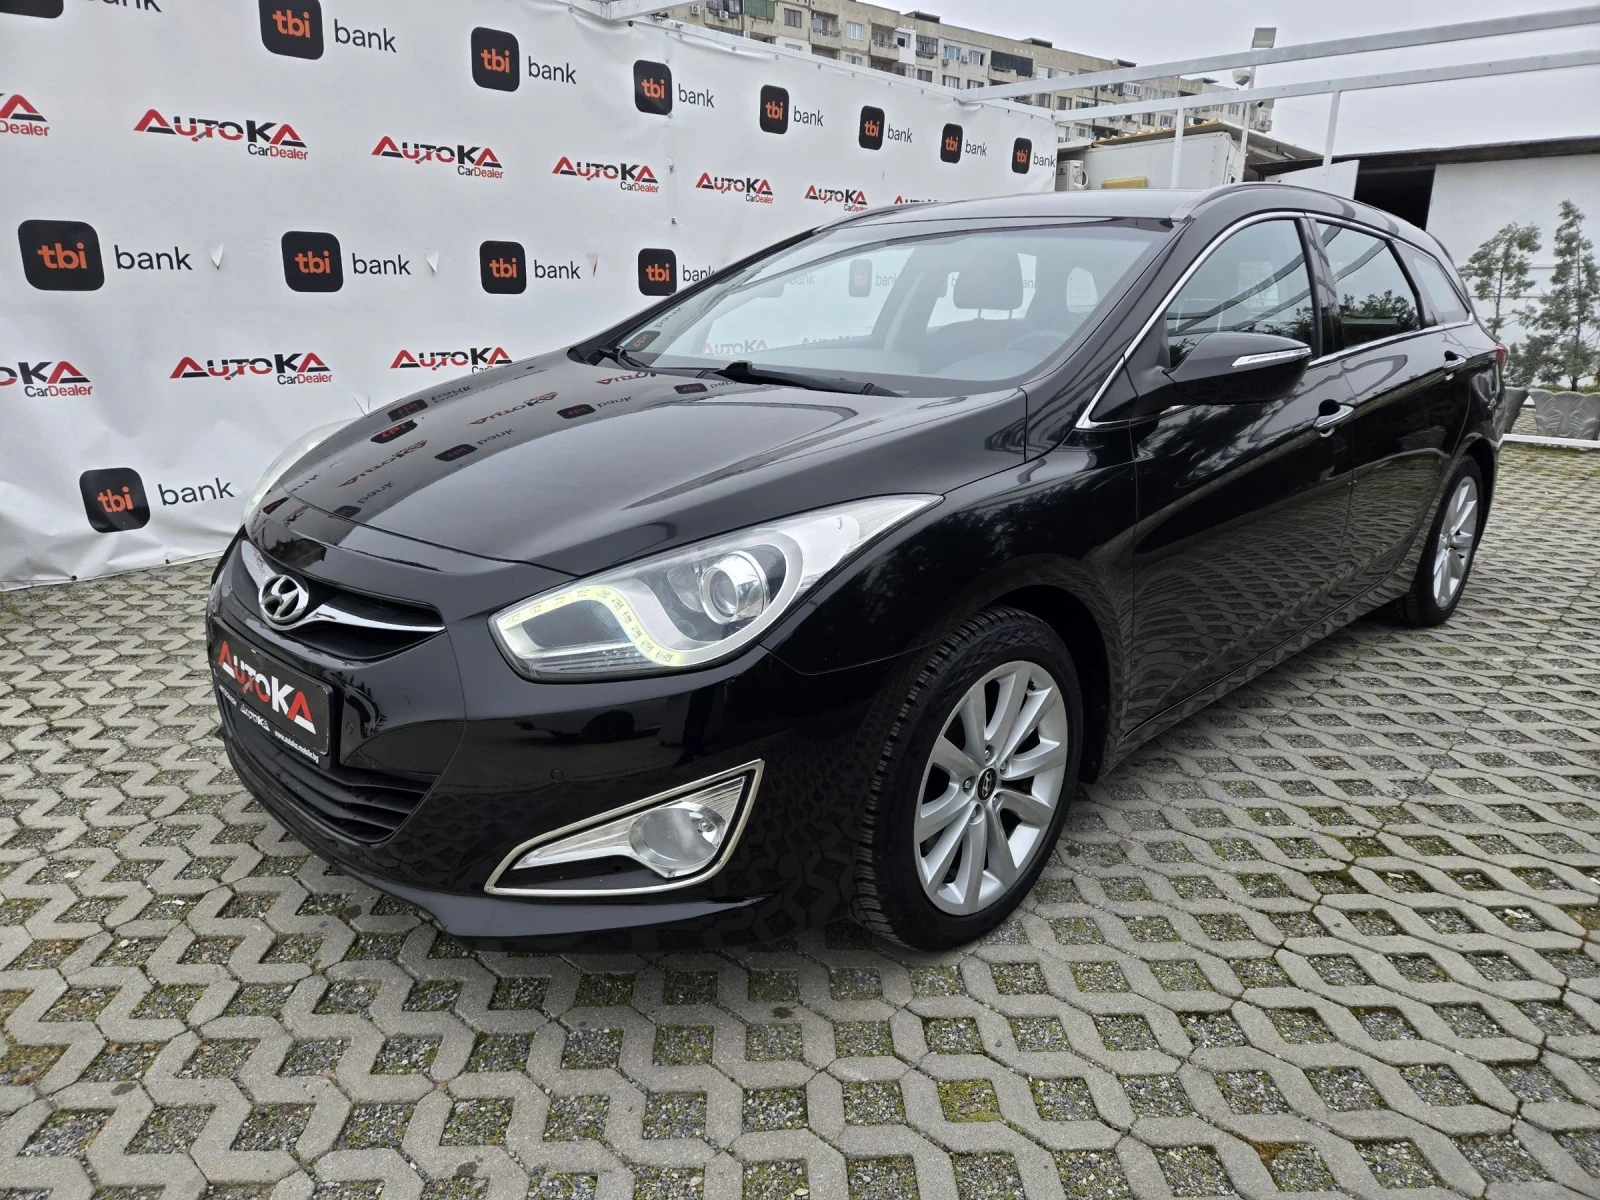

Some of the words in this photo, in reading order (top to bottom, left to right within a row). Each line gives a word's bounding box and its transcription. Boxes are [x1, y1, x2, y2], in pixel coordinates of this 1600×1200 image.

[272, 10, 311, 39] tbi
[334, 19, 397, 53] bank
[480, 49, 511, 73] tbi
[528, 56, 577, 84] bank
[641, 78, 665, 100] tbi
[678, 85, 715, 108] bank
[765, 101, 783, 120] tbi
[793, 109, 824, 127] bank
[864, 120, 879, 138] tbi
[887, 127, 913, 144] bank
[248, 143, 308, 160] CarDealer
[945, 136, 959, 152] tbi
[964, 140, 988, 157] bank
[1016, 150, 1028, 164] tbi
[1033, 152, 1056, 168] bank
[457, 165, 504, 179] CarDealer
[620, 181, 660, 193] CarDealer
[37, 242, 87, 270] tbi
[114, 245, 193, 271] bank
[294, 250, 331, 274] tbi
[352, 253, 411, 275] bank
[489, 257, 518, 279] tbi
[534, 260, 581, 280] bank
[645, 264, 671, 283] tbi
[277, 372, 333, 385] CarDealer
[24, 384, 93, 398] CarDealer
[97, 486, 134, 513] tbi
[157, 477, 235, 506] bank
